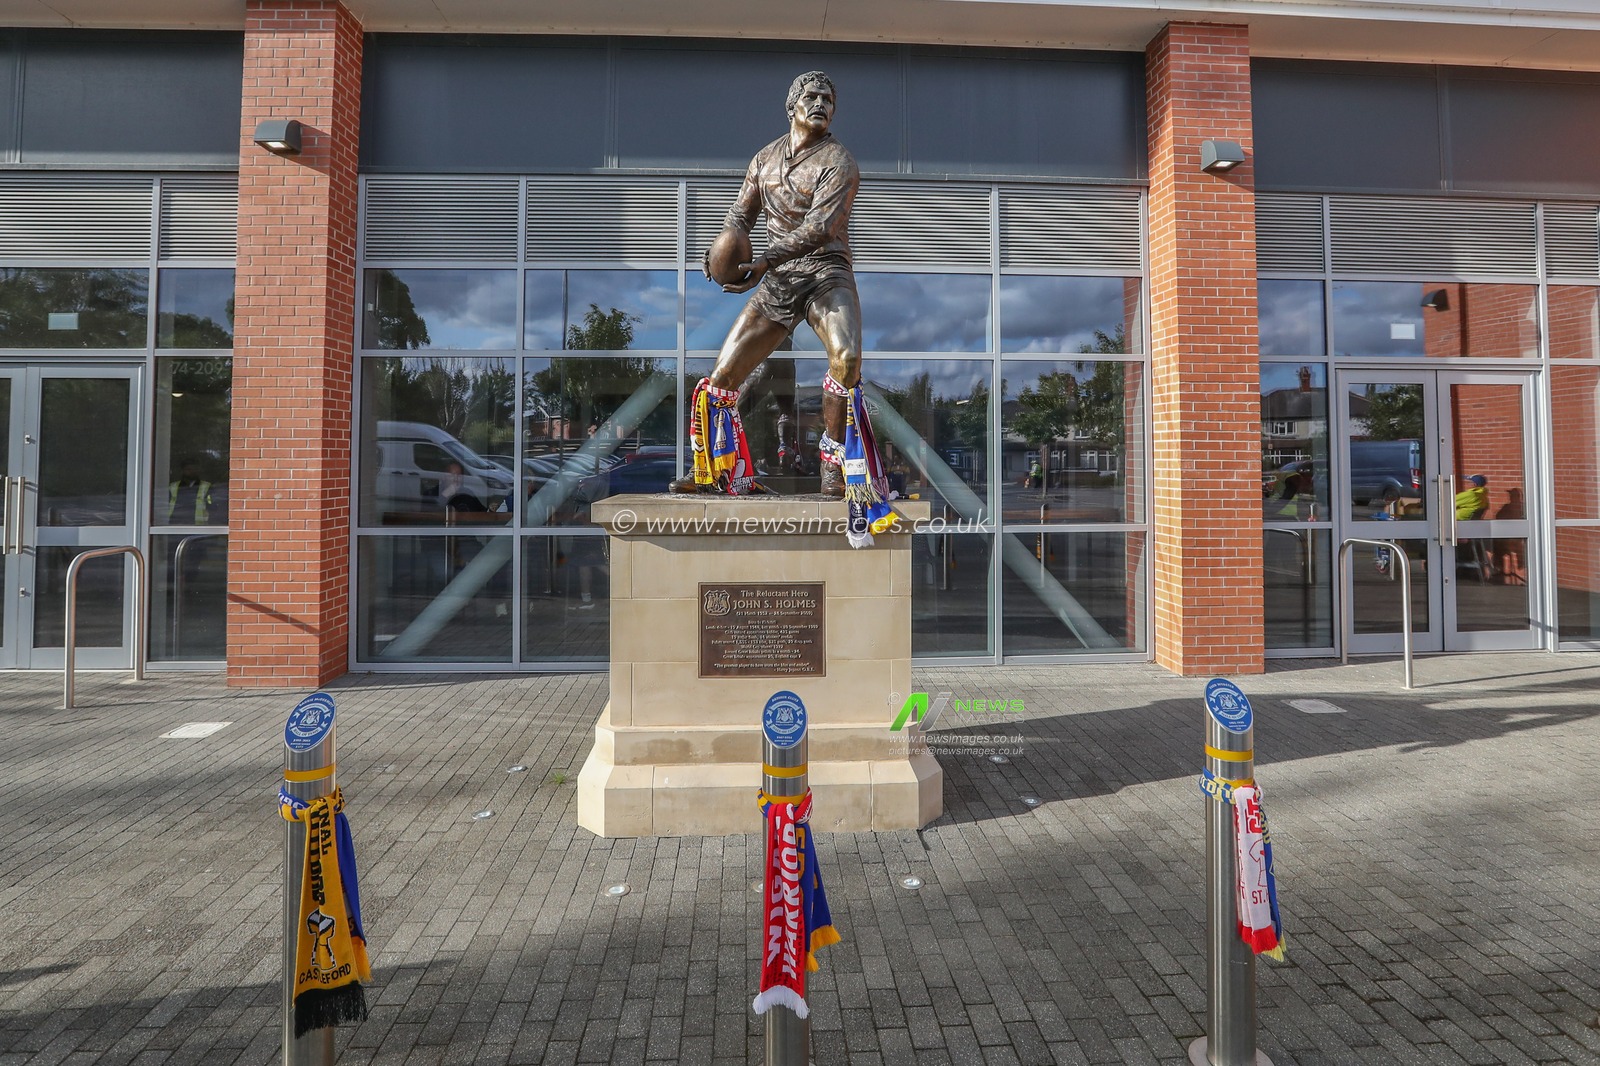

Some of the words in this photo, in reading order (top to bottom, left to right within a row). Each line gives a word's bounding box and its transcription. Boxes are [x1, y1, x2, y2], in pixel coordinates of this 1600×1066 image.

[733, 599, 761, 610] JOHN
[764, 600, 772, 609] S.
[776, 599, 816, 609] HOLMES
[318, 798, 332, 855] INAL
[299, 962, 351, 984] CASEFORD
